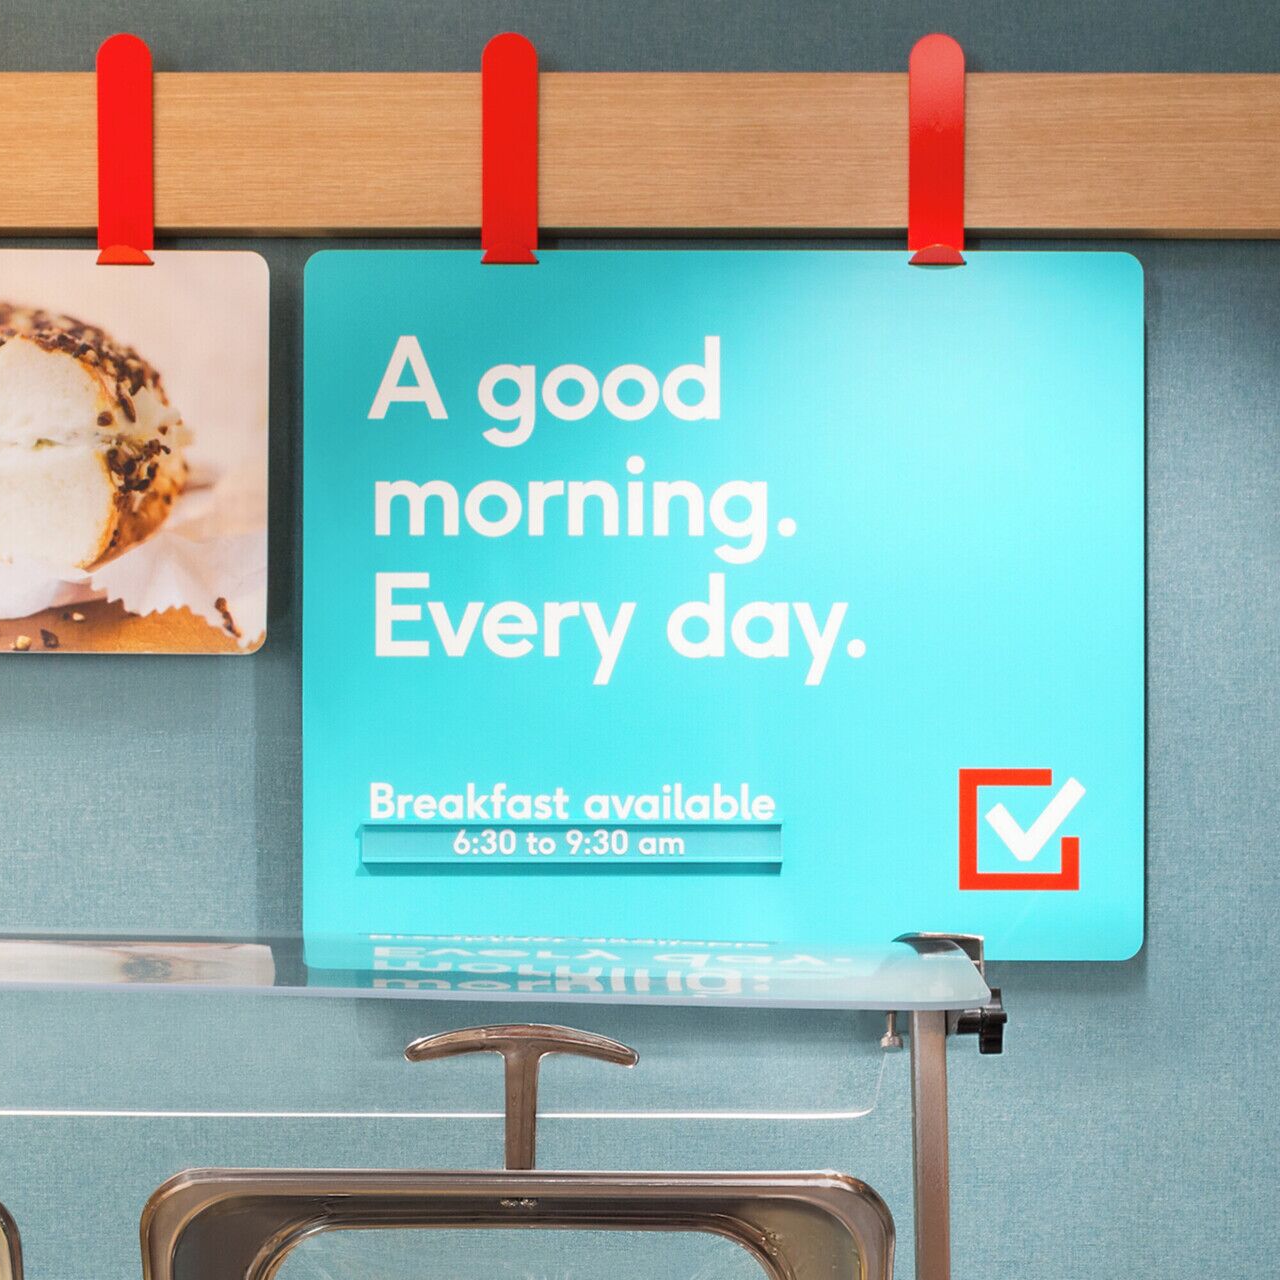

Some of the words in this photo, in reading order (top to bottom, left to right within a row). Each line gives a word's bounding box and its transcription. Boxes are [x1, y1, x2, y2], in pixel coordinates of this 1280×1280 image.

[368, 335, 448, 419] A
[478, 335, 721, 447] good
[375, 455, 797, 565] morning.
[375, 572, 637, 685] Every
[666, 572, 866, 686] day.
[370, 782, 569, 820] Breakfast
[584, 783, 776, 821] available
[453, 830, 517, 855] 6:30
[526, 832, 556, 855] to
[566, 830, 629, 855] 9:30
[638, 837, 685, 855] am
